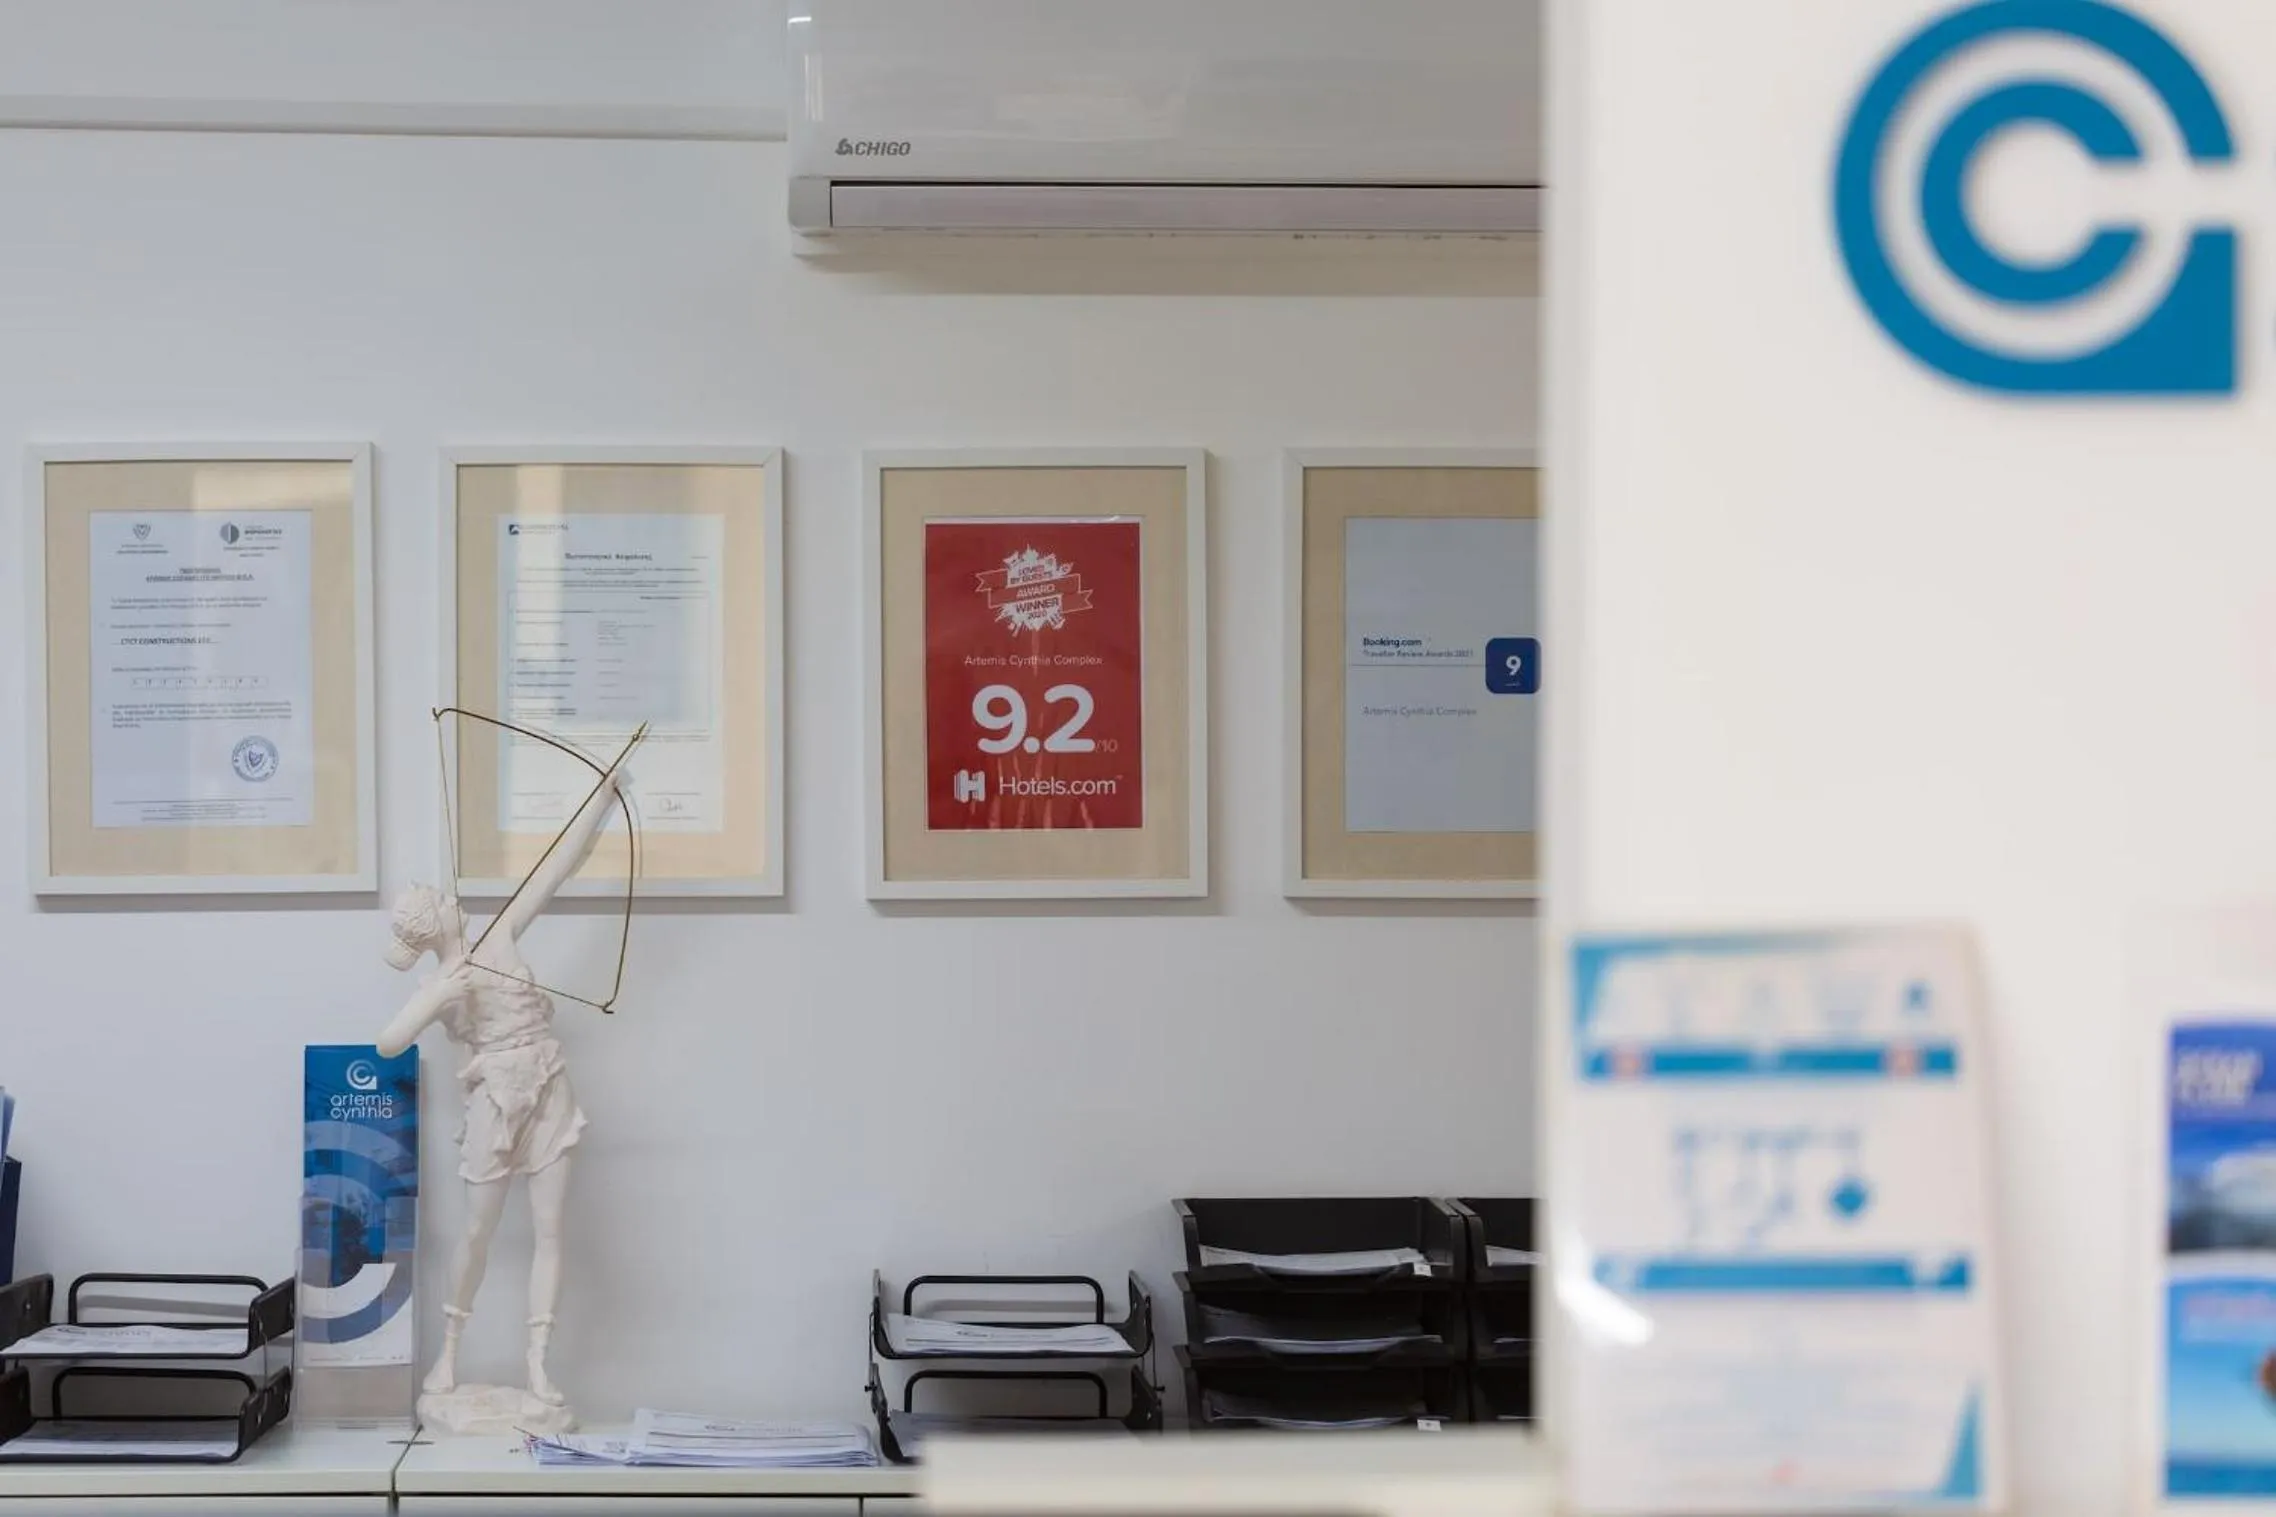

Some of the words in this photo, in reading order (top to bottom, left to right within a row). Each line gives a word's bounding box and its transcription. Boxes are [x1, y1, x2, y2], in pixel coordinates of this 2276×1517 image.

[856, 141, 911, 156] CHIGO
[1016, 583, 1056, 599] AWARD
[1016, 597, 1060, 612] WINNER
[1363, 637, 1423, 648] Booking.com
[965, 655, 1006, 666] Artemis
[1009, 654, 1051, 667] Cynthia
[1054, 654, 1103, 667] Complex
[1506, 655, 1521, 676] 9
[972, 684, 1095, 754] 9.2
[999, 777, 1117, 796] Hotels.com
[330, 1093, 393, 1107] artemis
[330, 1106, 393, 1121] cynthia
